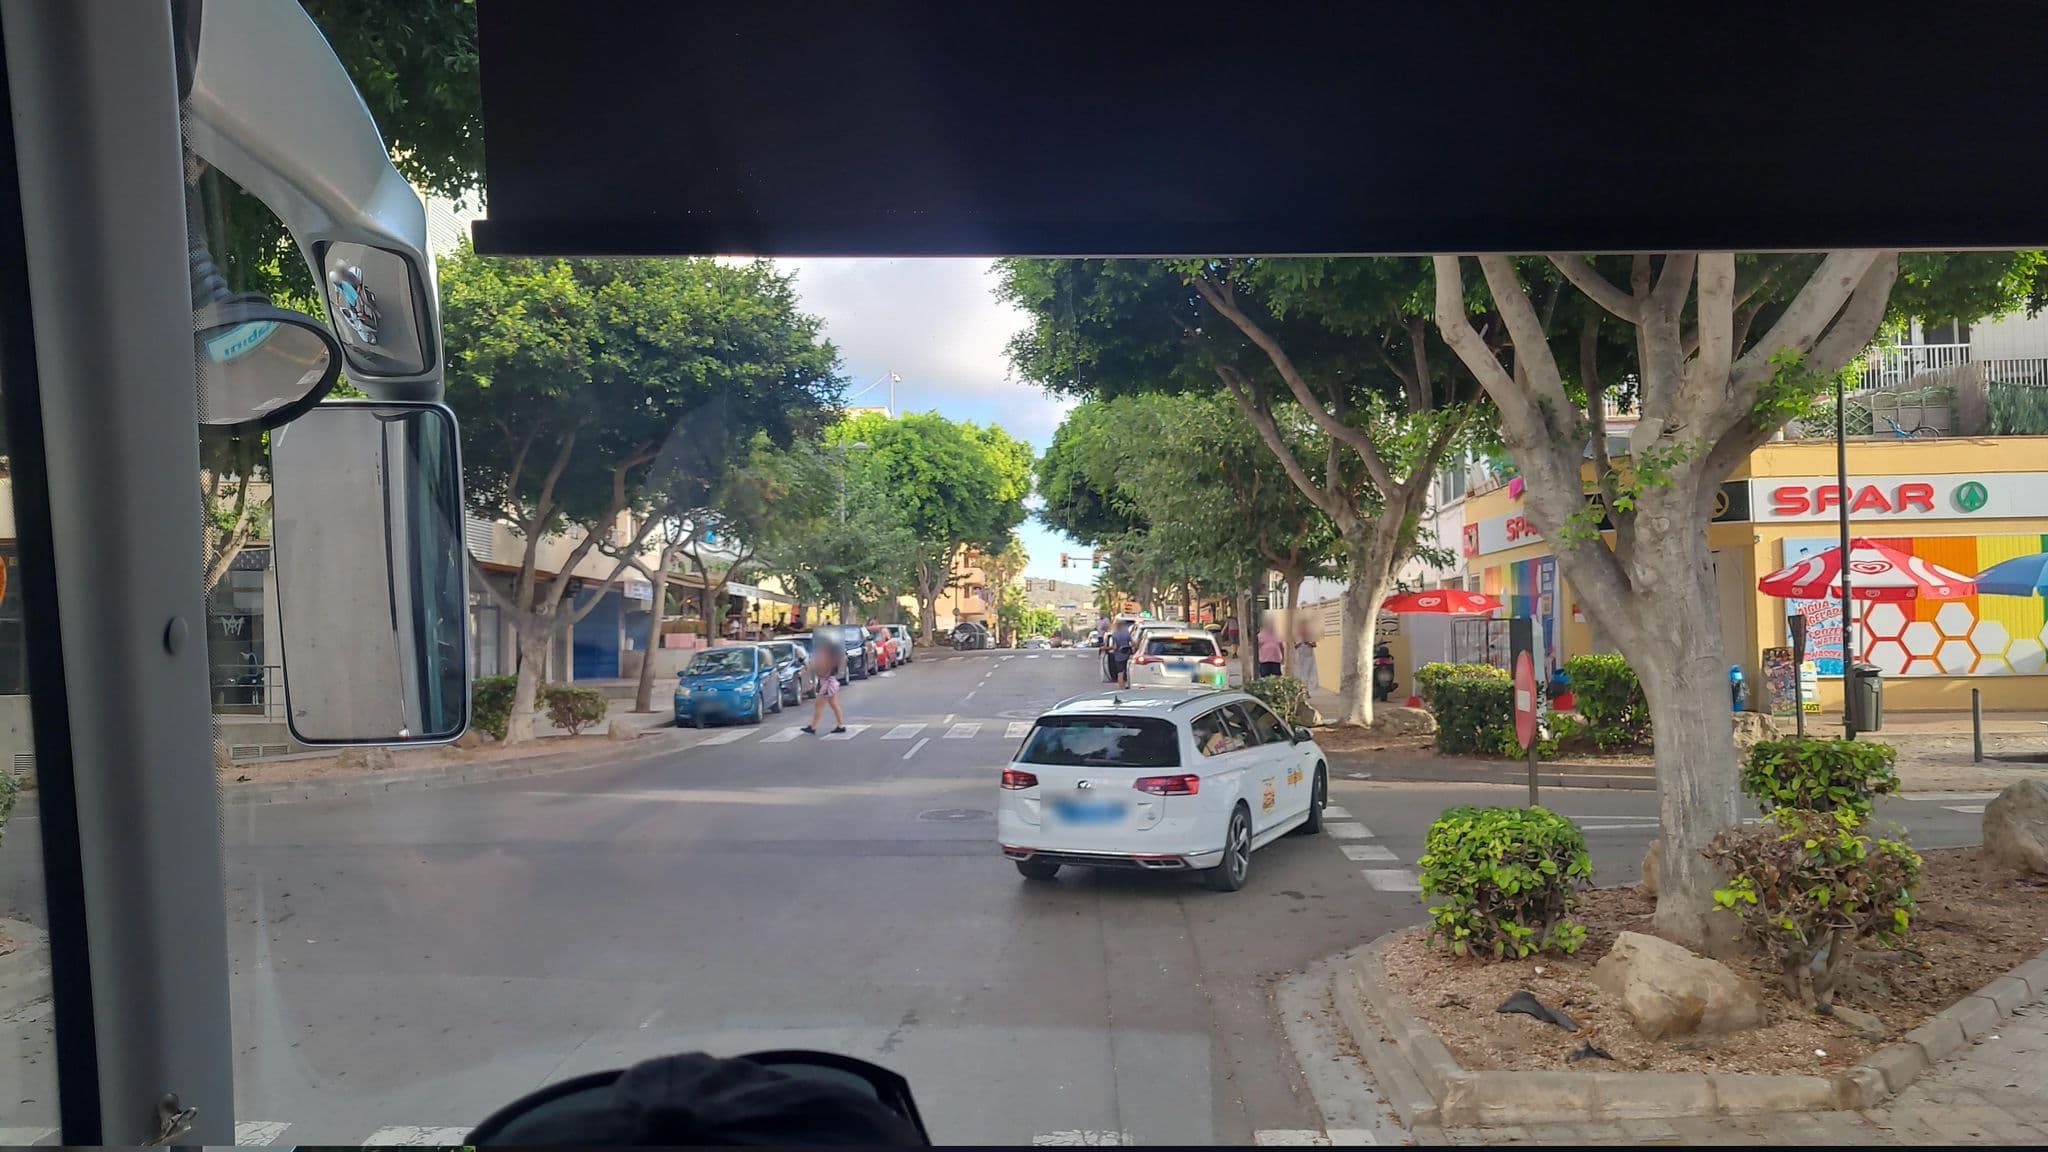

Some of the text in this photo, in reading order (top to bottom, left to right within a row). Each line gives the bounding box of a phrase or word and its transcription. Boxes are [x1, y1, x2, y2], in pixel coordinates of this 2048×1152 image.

[1774, 483, 1935, 514] SPAR
[1506, 515, 1538, 542] SPA
[1808, 627, 1844, 638] FROZE
